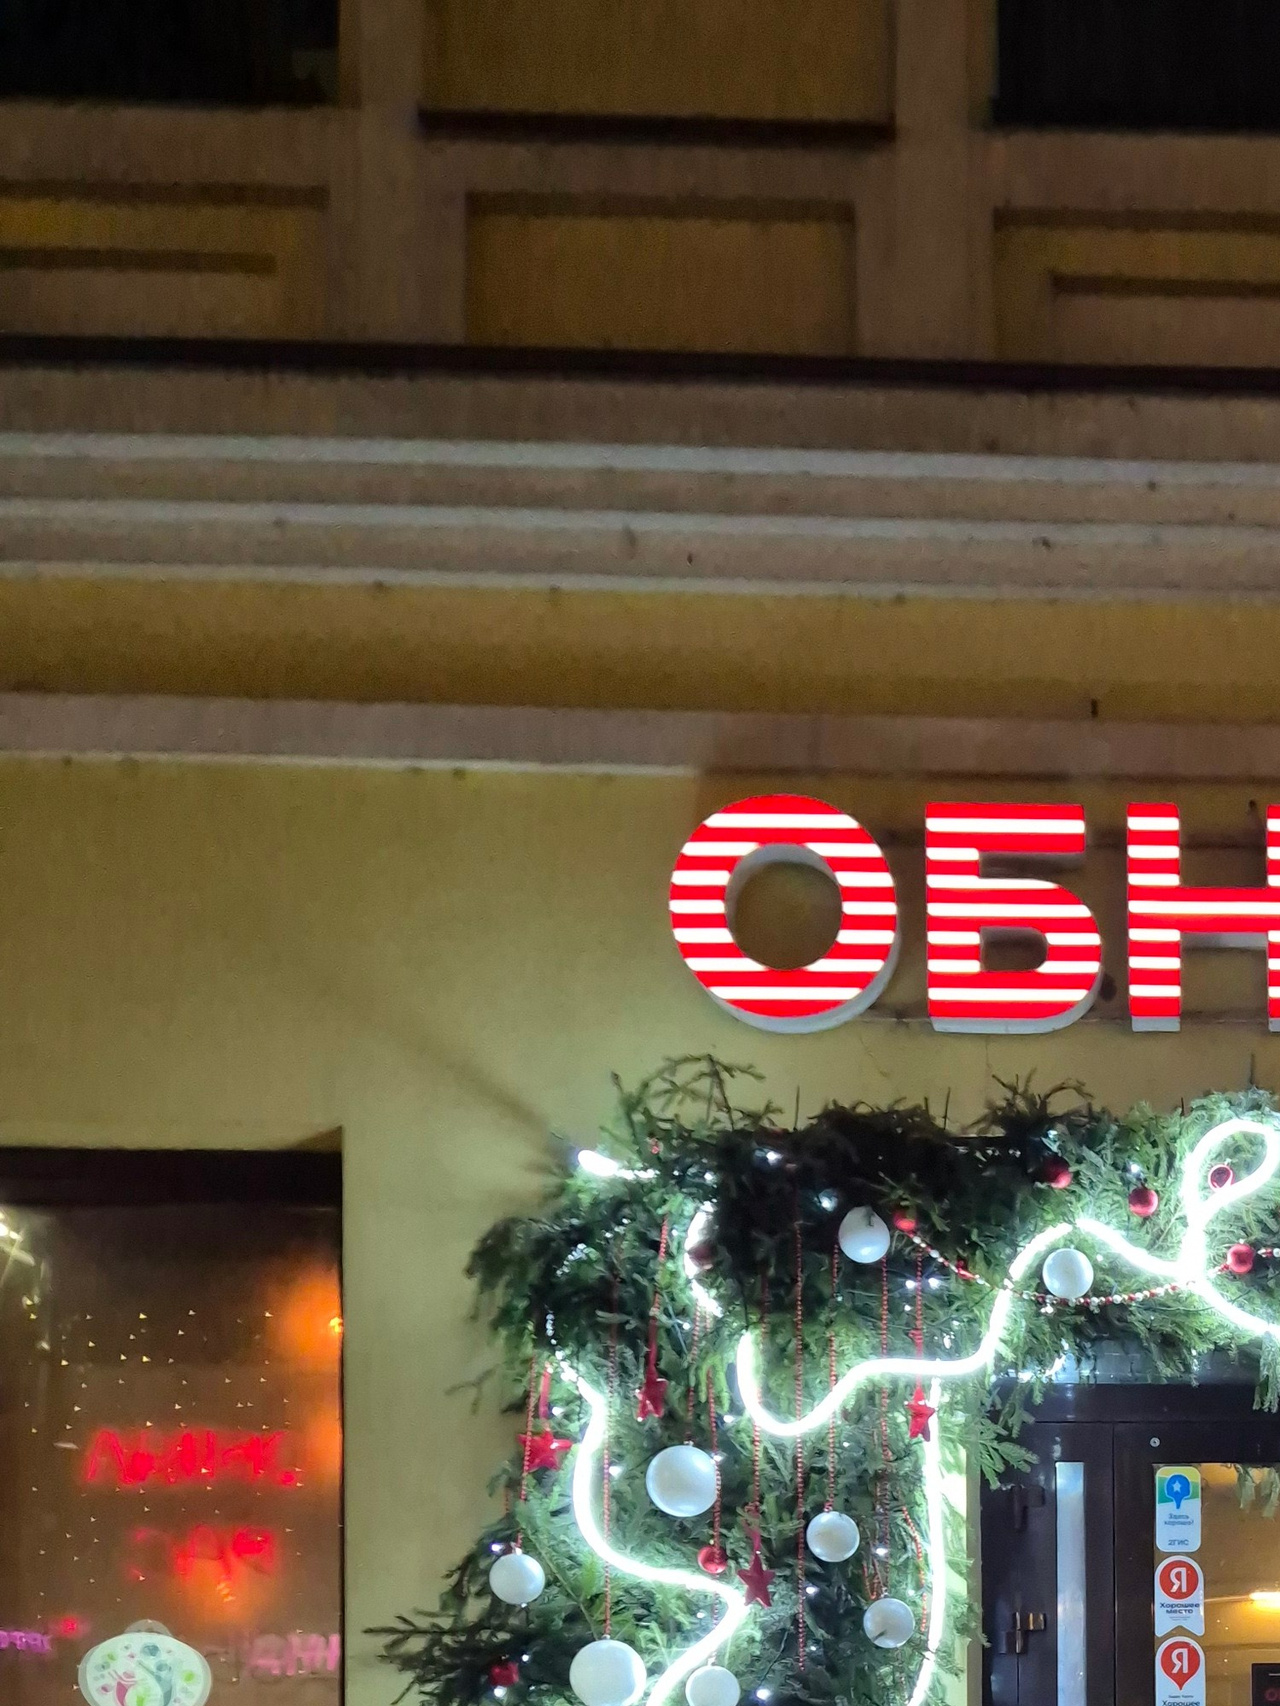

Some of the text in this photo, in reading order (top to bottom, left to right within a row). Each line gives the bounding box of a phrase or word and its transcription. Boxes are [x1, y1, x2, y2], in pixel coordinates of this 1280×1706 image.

[1169, 1566, 1187, 1593] Я
[1171, 1647, 1189, 1674] Я
[1161, 1699, 1200, 1706] Хорошее
